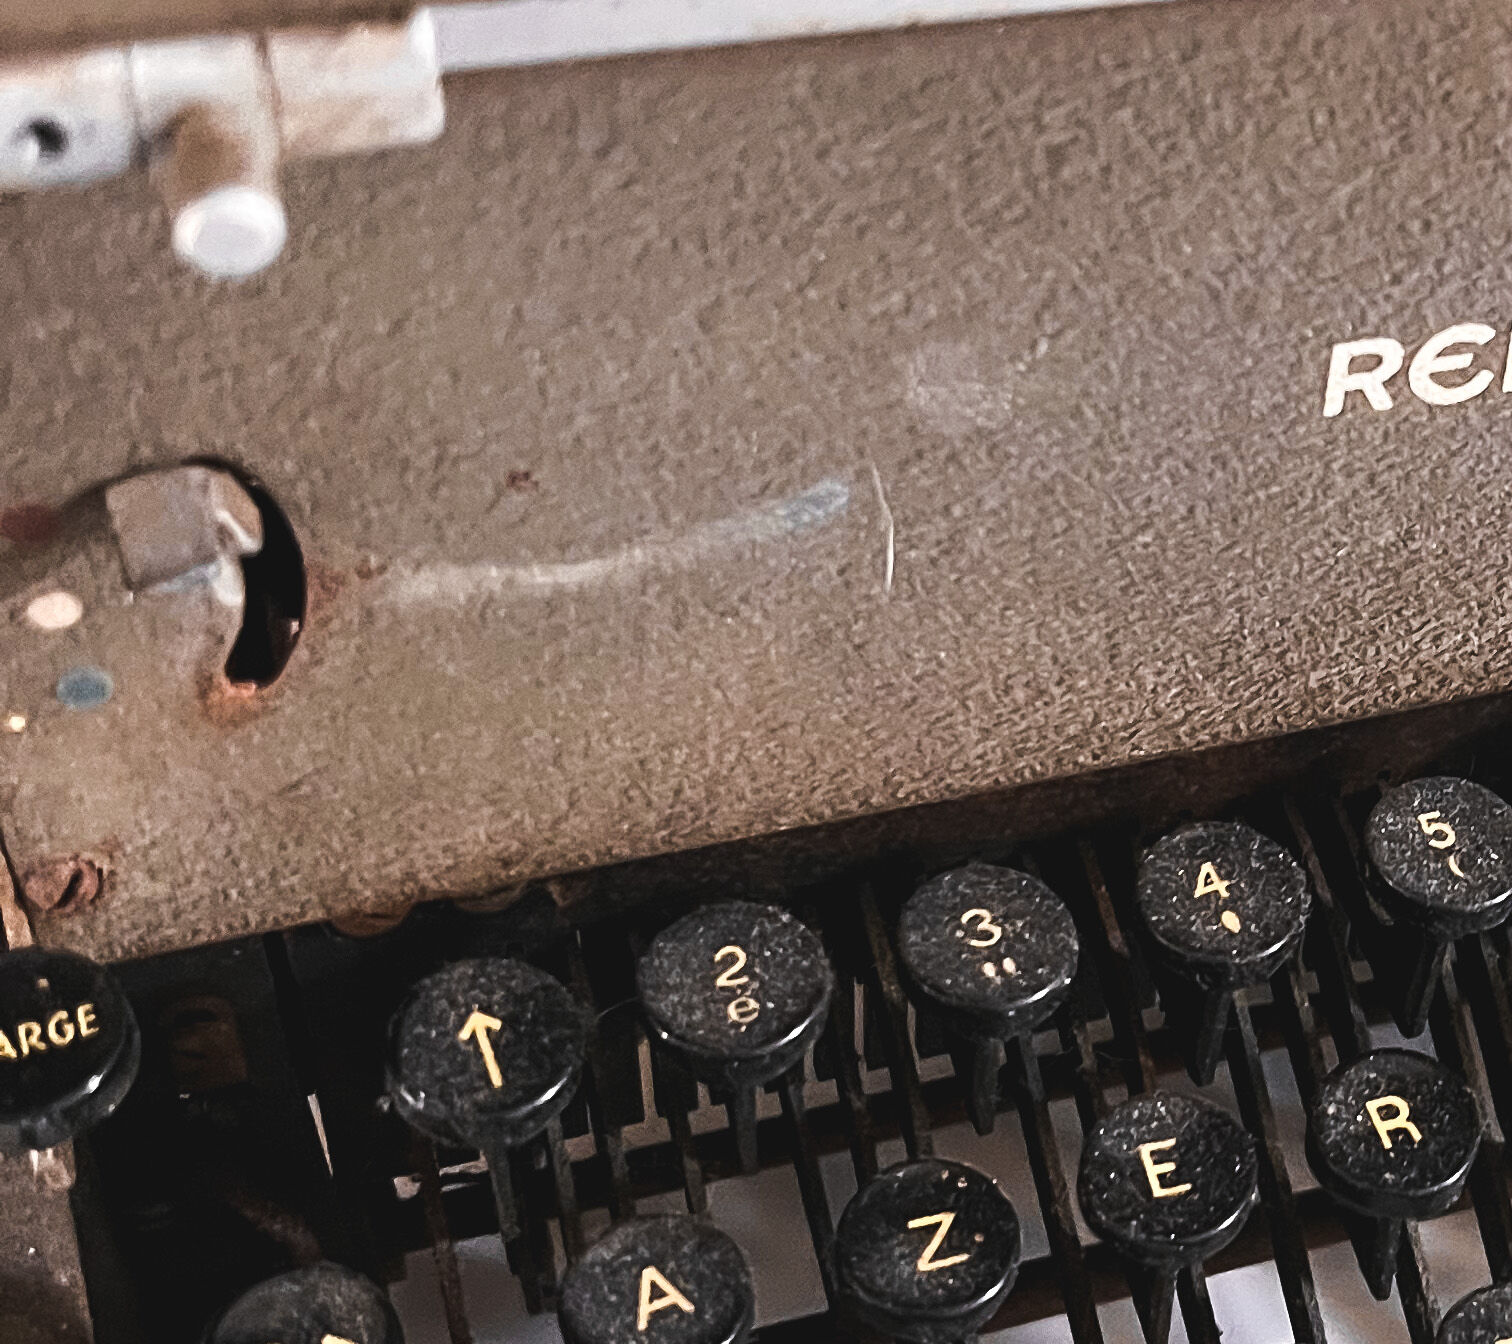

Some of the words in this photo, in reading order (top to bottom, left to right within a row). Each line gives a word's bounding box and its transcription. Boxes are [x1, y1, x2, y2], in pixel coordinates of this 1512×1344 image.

[1417, 809, 1456, 850] 5
[1193, 861, 1229, 899] 4
[960, 908, 1002, 948] 3
[714, 945, 749, 987] 2
[1365, 1095, 1423, 1150] R
[1136, 1137, 1192, 1198] E
[907, 1212, 970, 1272] Z
[637, 1266, 695, 1331] A
